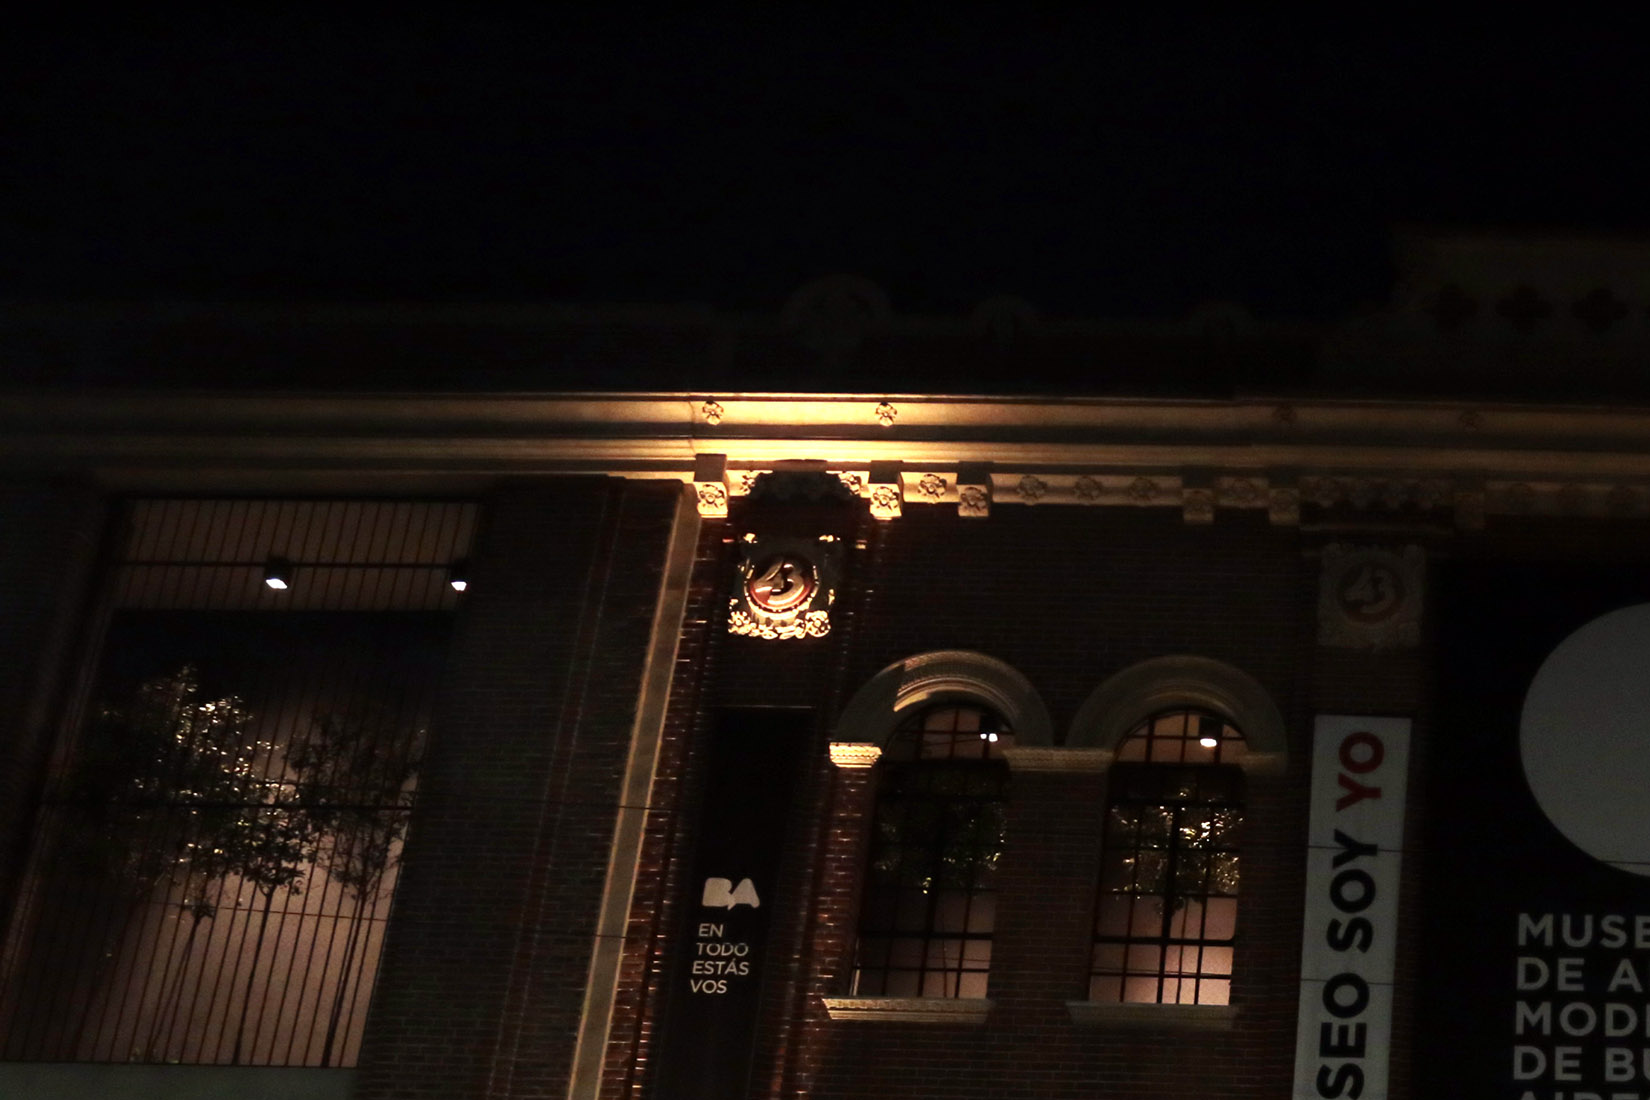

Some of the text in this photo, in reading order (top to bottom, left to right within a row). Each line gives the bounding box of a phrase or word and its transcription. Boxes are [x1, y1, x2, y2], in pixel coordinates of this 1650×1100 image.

[1336, 731, 1385, 812] YO
[702, 876, 760, 911] BA
[1326, 828, 1378, 953] SOY
[698, 923, 724, 938] EN
[692, 957, 750, 976] ESTÁS
[696, 942, 749, 957] TODO
[689, 978, 728, 994] VOS
[1516, 956, 1586, 992] DE
[1512, 1044, 1583, 1081] DE
